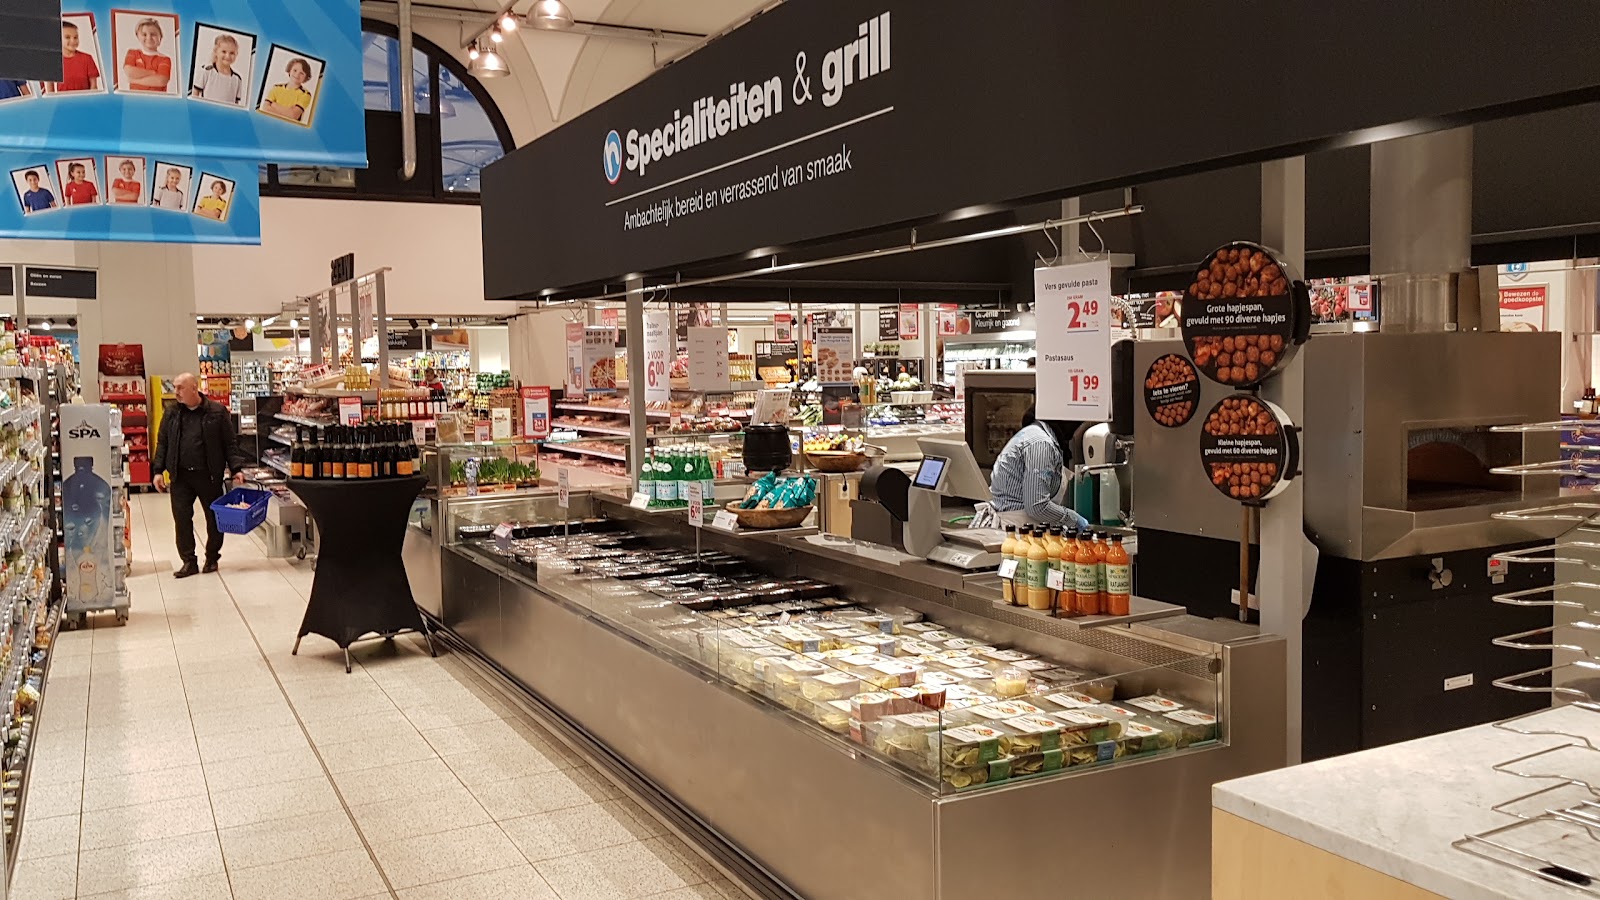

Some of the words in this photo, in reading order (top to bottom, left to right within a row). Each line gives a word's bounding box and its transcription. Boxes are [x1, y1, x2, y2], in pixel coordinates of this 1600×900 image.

[625, 75, 783, 177] Specialiteiten
[792, 51, 813, 105] &
[821, 11, 891, 108] grill
[624, 199, 674, 231] Ambachtelijk
[675, 188, 703, 218] bereid
[705, 190, 718, 208] en
[720, 164, 779, 205] verrassend
[781, 164, 803, 188] van
[806, 143, 852, 181] smaak
[1057, 280, 1080, 290] gevulde
[1081, 279, 1098, 288] pasta
[1503, 296, 1544, 304] goedkoopste!
[1206, 304, 1225, 313] Grote
[1226, 303, 1264, 314] hapjespan,
[1186, 316, 1209, 327] gevuld
[1210, 316, 1224, 324] met
[1225, 315, 1234, 324] 90
[1235, 314, 1261, 323] diverse
[1262, 313, 1286, 325] hapjes
[651, 350, 664, 360] VOOR
[1169, 383, 1188, 393] vieren?
[69, 428, 101, 439] SPA
[1234, 438, 1263, 449] hapjespan,
[1204, 447, 1222, 456] gevuld
[1240, 446, 1260, 455] diverse
[1260, 447, 1278, 457] hapjes
